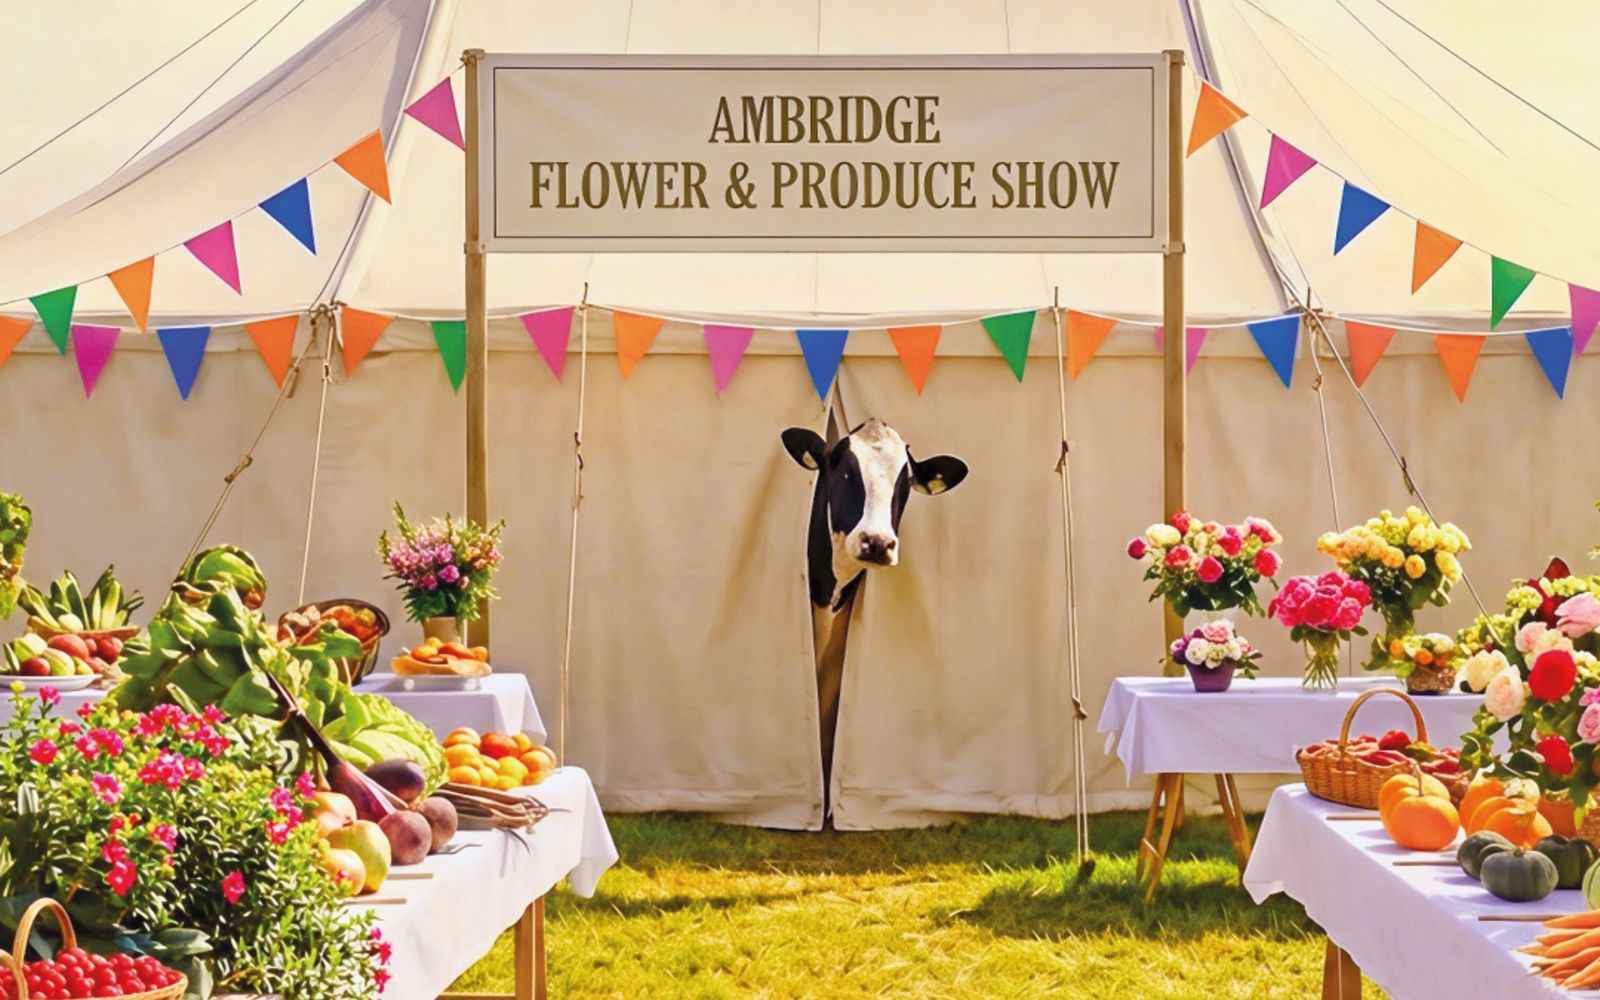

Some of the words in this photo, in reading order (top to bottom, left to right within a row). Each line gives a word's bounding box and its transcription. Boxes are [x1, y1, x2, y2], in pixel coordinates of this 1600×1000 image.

[708, 95, 941, 144] AMBRIDGE
[529, 161, 710, 209] FLOWER
[725, 161, 758, 210] &
[771, 161, 977, 210] PRODUCE
[991, 160, 1121, 210] SHOW
